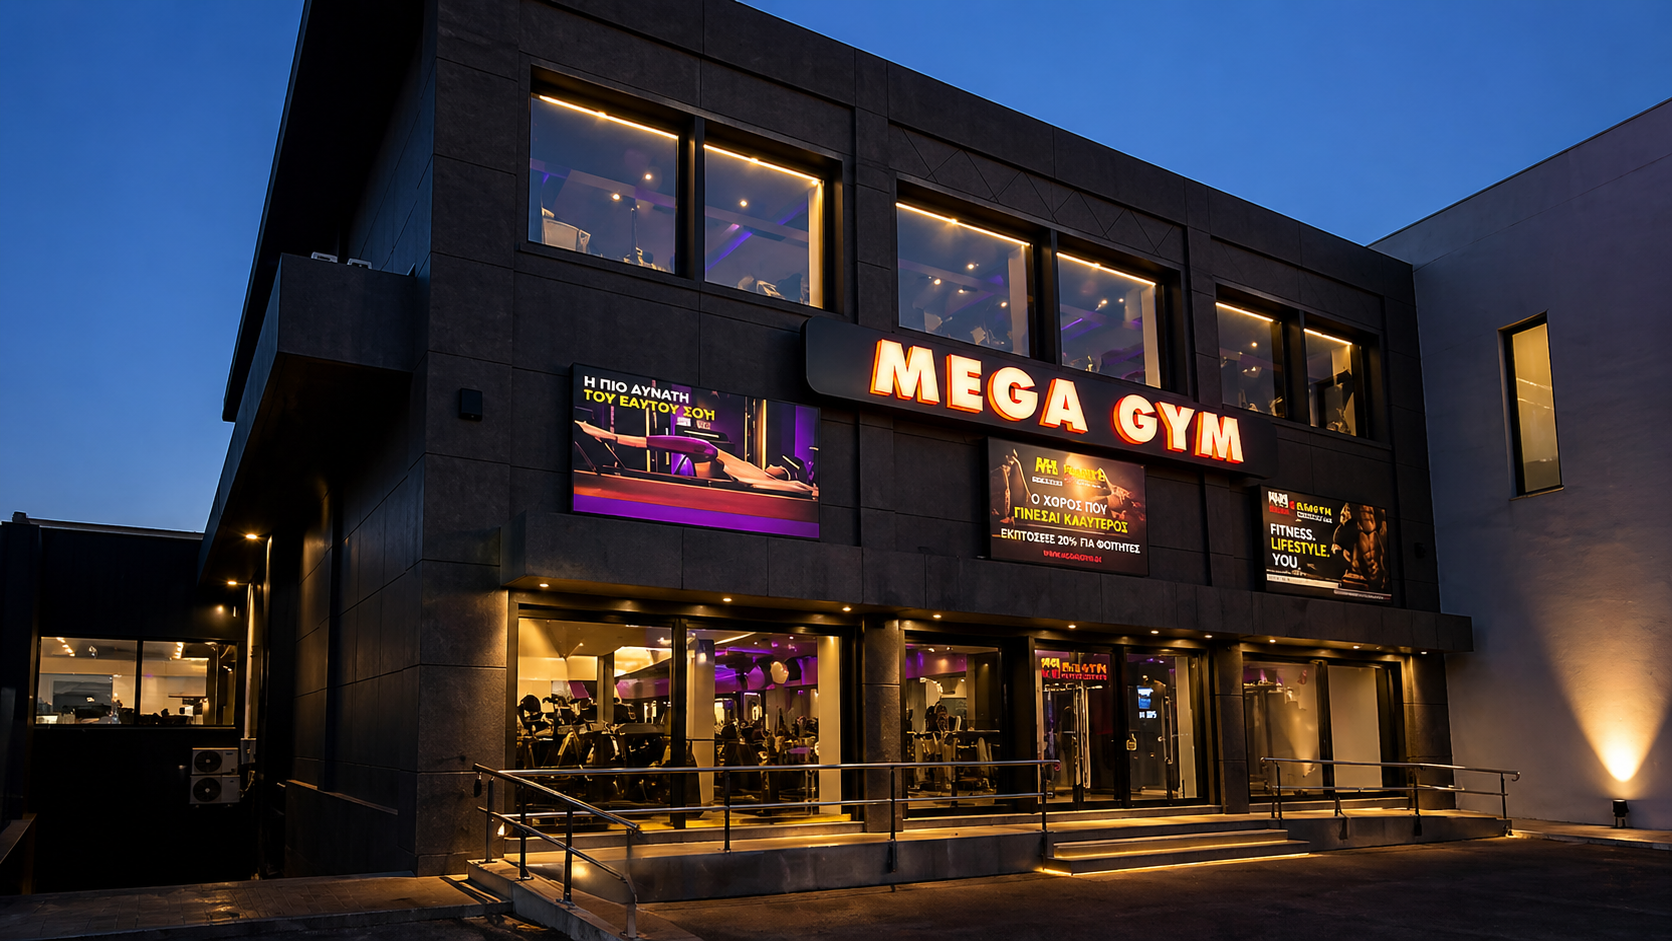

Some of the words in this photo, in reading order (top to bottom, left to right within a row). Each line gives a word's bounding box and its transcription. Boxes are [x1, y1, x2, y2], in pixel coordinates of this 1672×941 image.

[584, 375, 596, 388] Η
[600, 378, 628, 393] ΠΙΟ
[631, 384, 690, 404] ΔΥΝΑΤΗ
[583, 389, 616, 404] ΤΟΥ
[619, 395, 680, 415] ΕΑΥΤΟΥ
[868, 337, 1089, 435] MEGA
[1113, 393, 1245, 464] GYM
[1030, 493, 1040, 505] Ο
[1085, 501, 1107, 515] ΠΟΥ
[1014, 506, 1060, 524] ΓΙΝΕΣΑΙ
[1057, 535, 1078, 547] 20%
[1270, 523, 1316, 541] FITNESS.
[1270, 537, 1331, 558] LIFESTYLE.
[1272, 552, 1302, 570] YOU.
